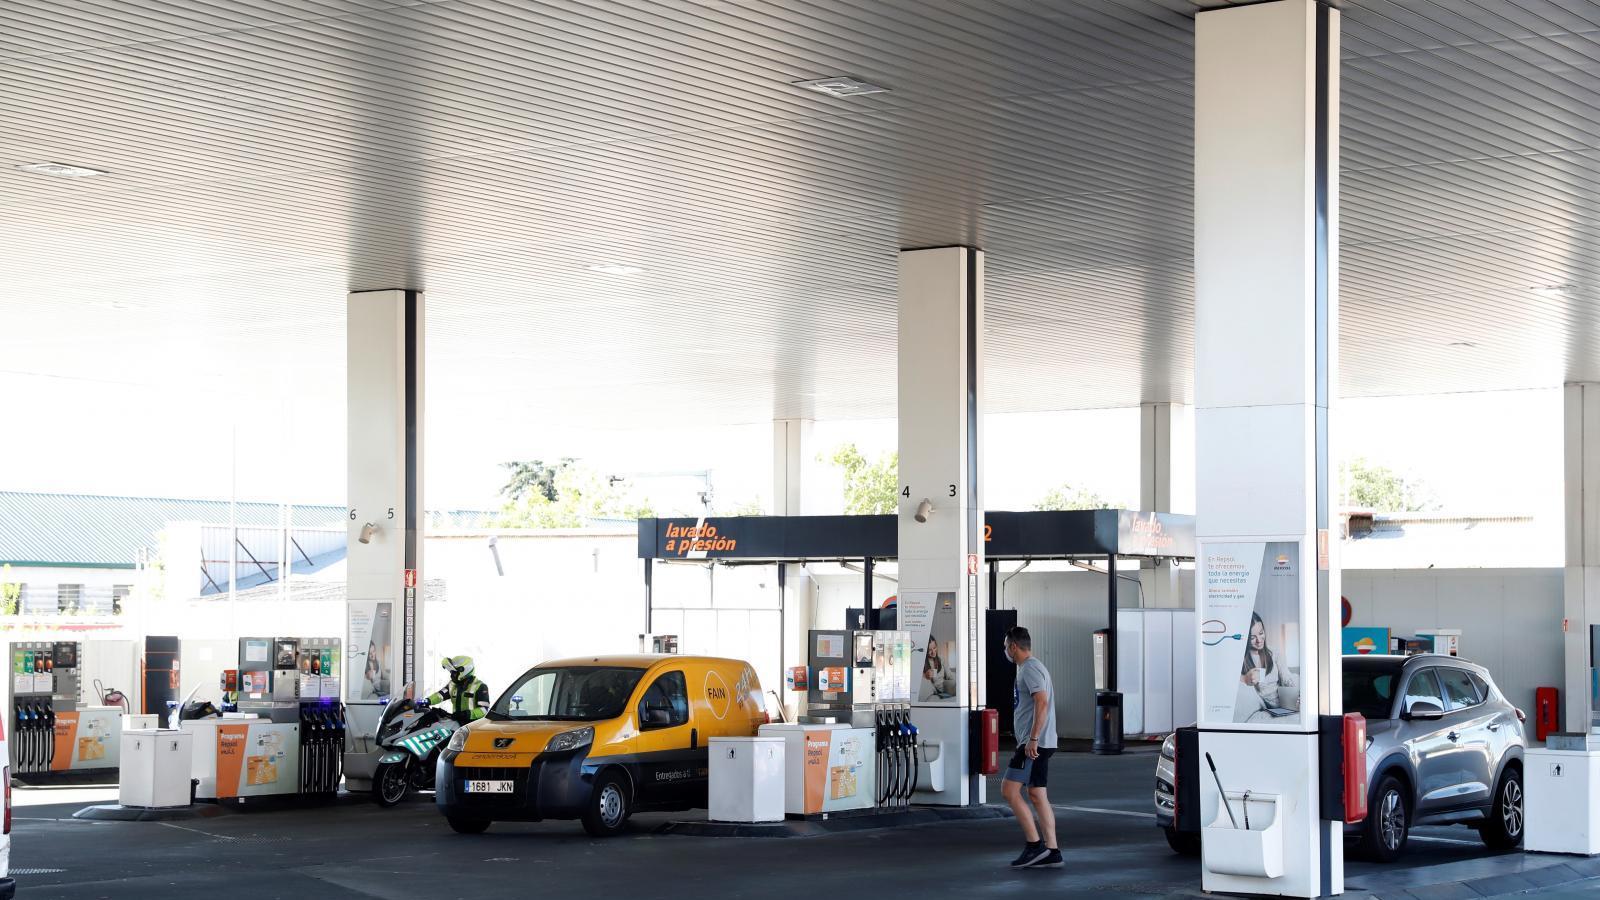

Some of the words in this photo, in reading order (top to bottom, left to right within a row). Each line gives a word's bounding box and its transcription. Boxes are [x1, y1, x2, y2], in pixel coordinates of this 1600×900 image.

[902, 485, 910, 498] 4
[949, 484, 956, 496] 3
[349, 508, 357, 521] 6
[387, 507, 394, 520] 5
[665, 522, 717, 538] lavado
[665, 539, 676, 551] a
[678, 535, 737, 556] presión
[707, 688, 726, 699] FAIN
[472, 782, 490, 792] 1681
[497, 782, 512, 792] JKN
